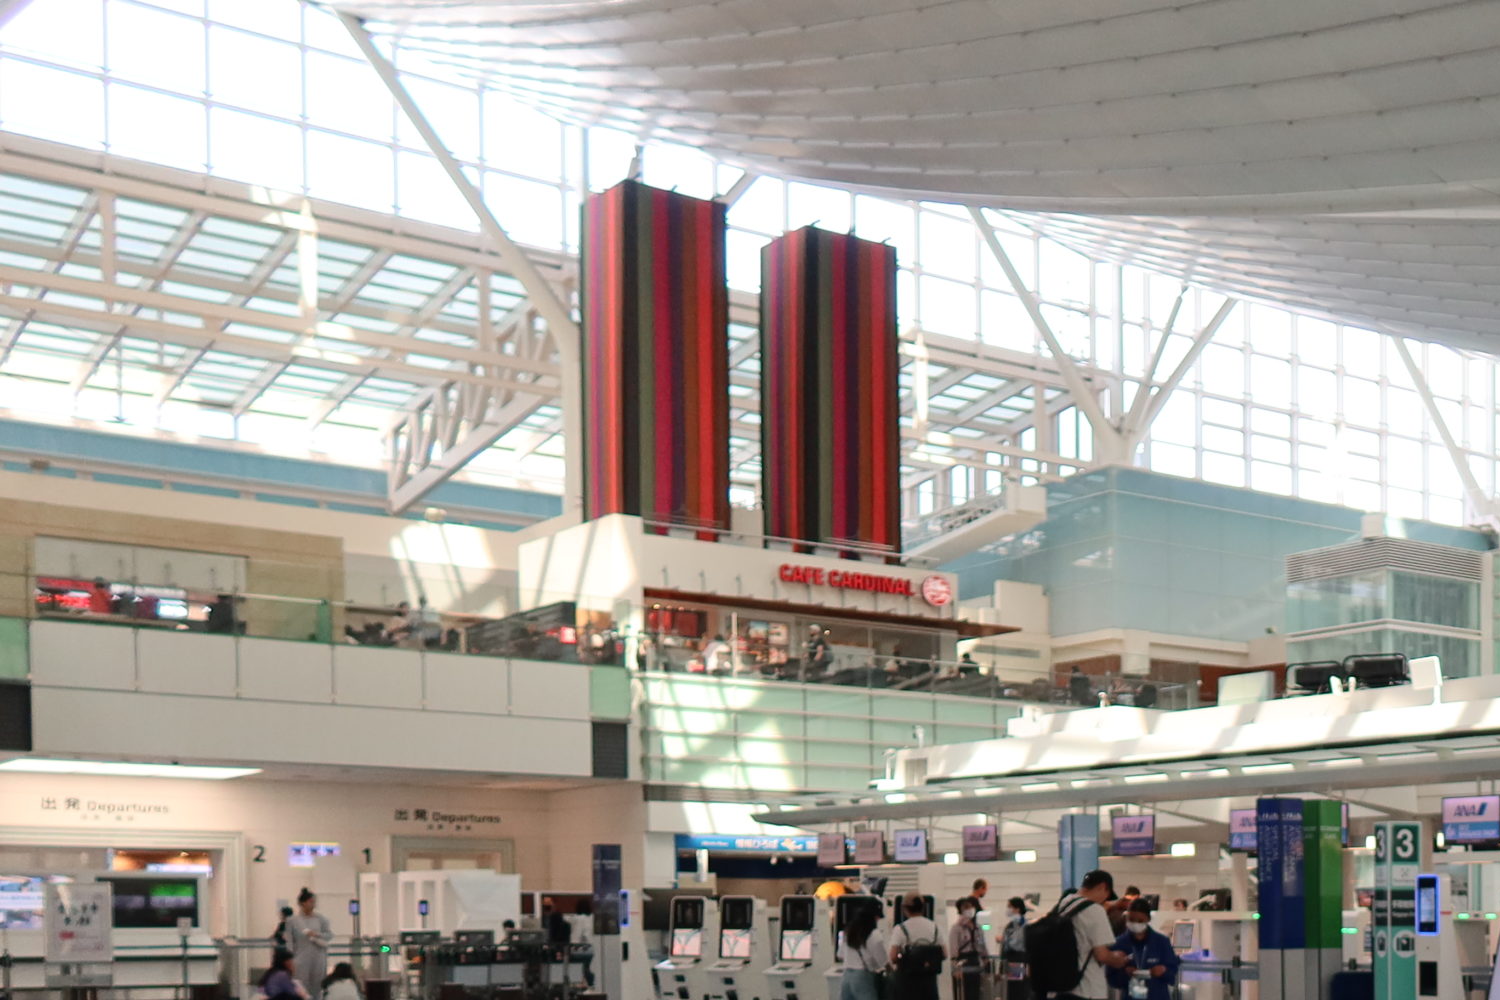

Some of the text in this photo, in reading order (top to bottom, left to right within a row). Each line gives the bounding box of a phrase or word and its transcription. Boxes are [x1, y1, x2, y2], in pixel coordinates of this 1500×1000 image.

[779, 564, 914, 597] CAFE CARDINAL
[87, 800, 168, 814] Departures
[1454, 805, 1476, 816] ANA
[432, 812, 501, 824] Departures
[1376, 829, 1385, 858] 3
[1396, 829, 1414, 858] 3
[253, 846, 265, 862] 2
[363, 848, 371, 864] 1
